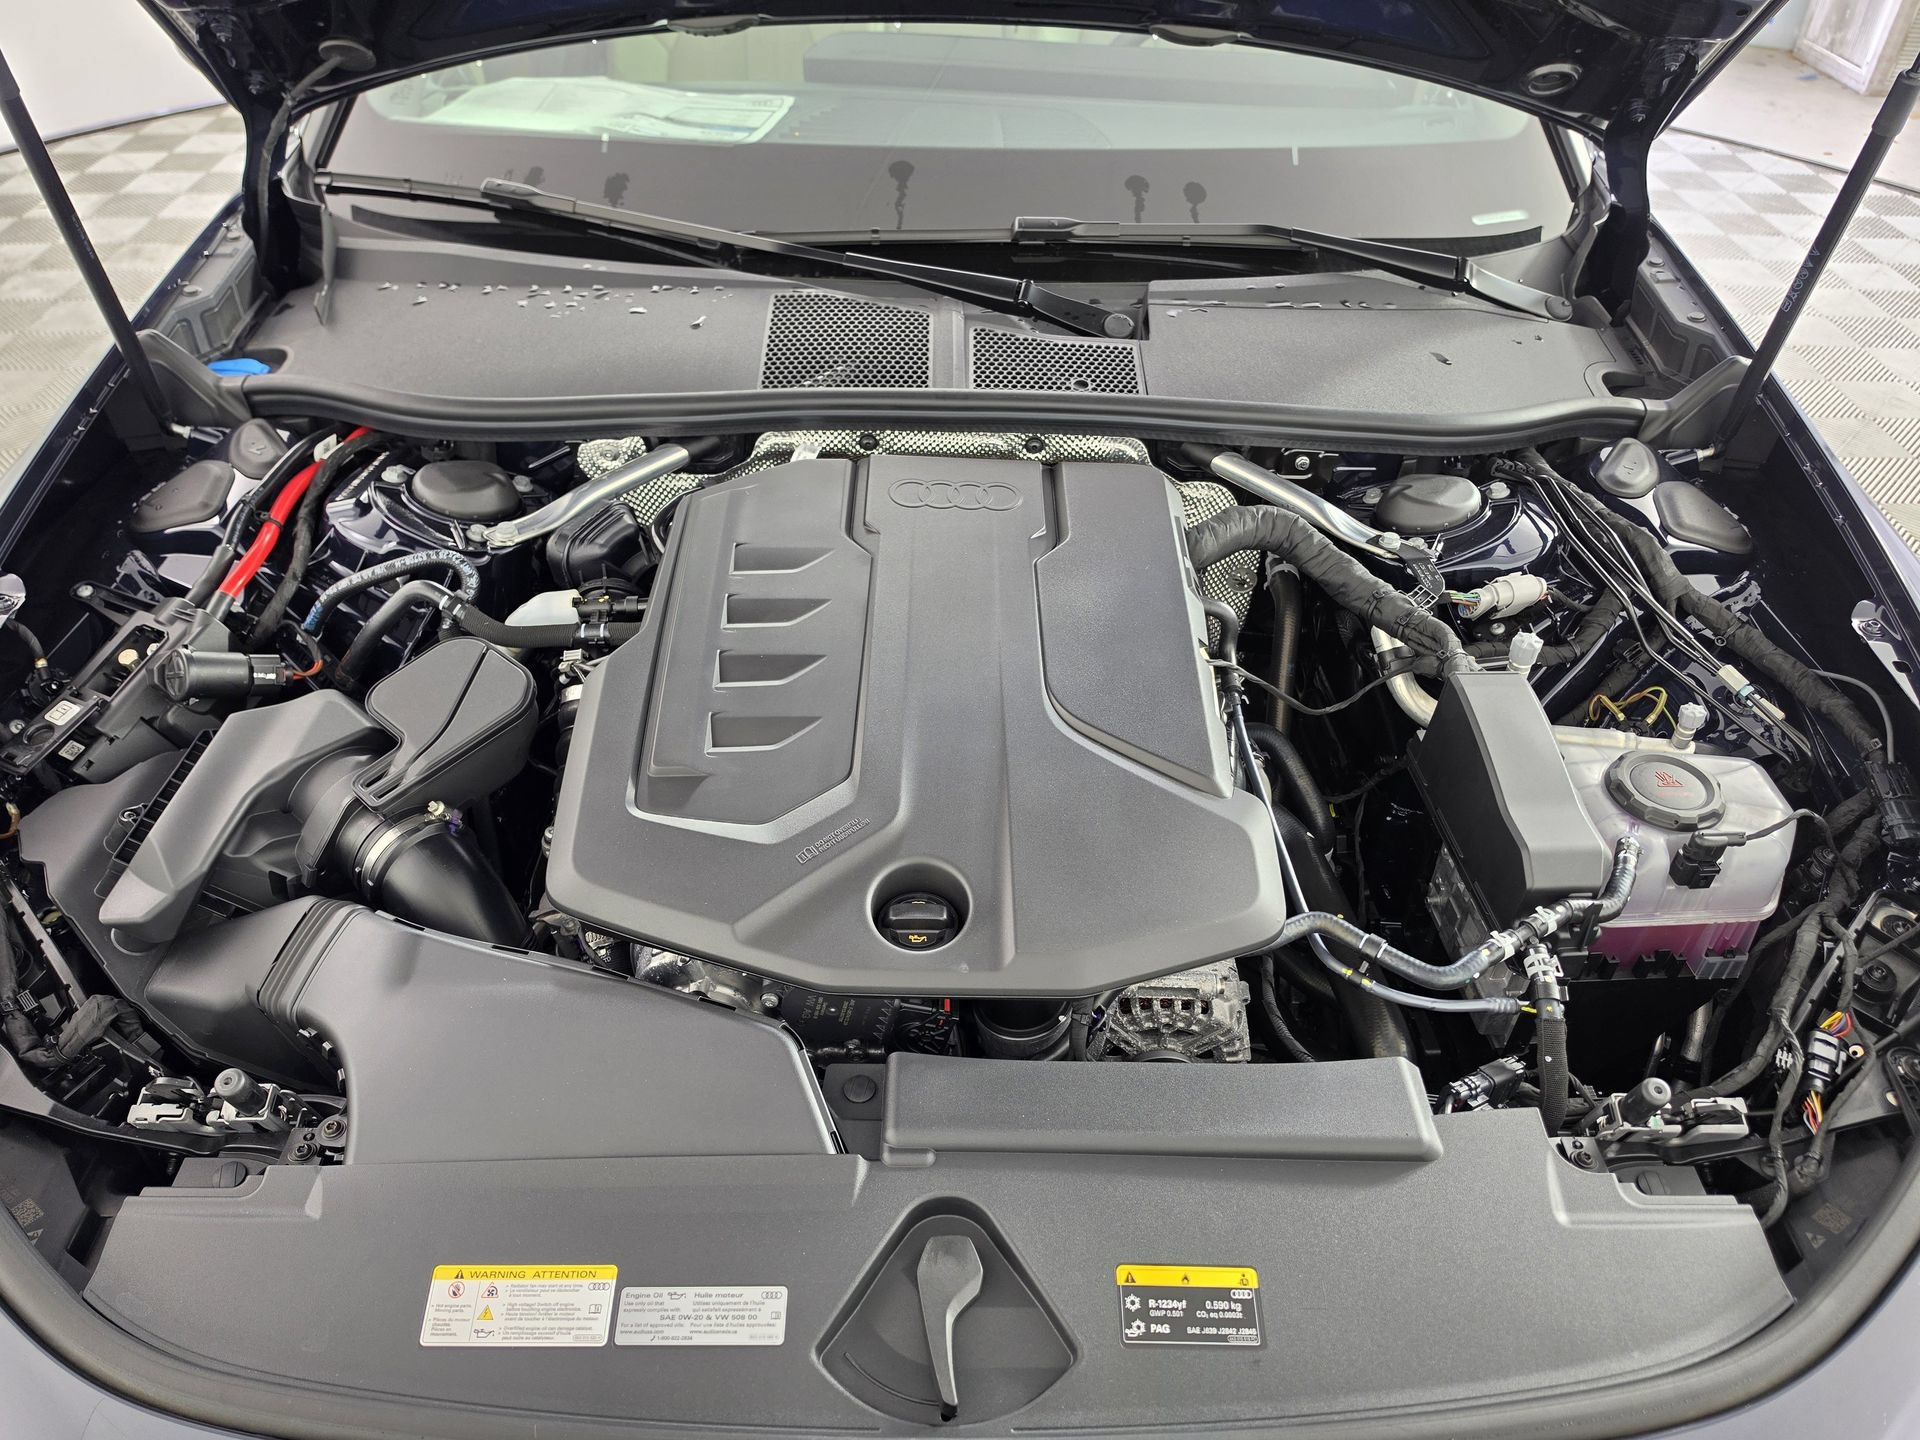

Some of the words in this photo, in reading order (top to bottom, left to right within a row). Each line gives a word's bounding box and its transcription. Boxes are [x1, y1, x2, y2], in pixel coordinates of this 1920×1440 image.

[469, 1270, 526, 1279] WARNING
[532, 1270, 597, 1279] ATTENTION
[1148, 1299, 1187, 1310] R-1234yf
[1205, 1301, 1229, 1310] 0.590
[1230, 1301, 1242, 1311] kg
[1150, 1324, 1170, 1334] PAG
